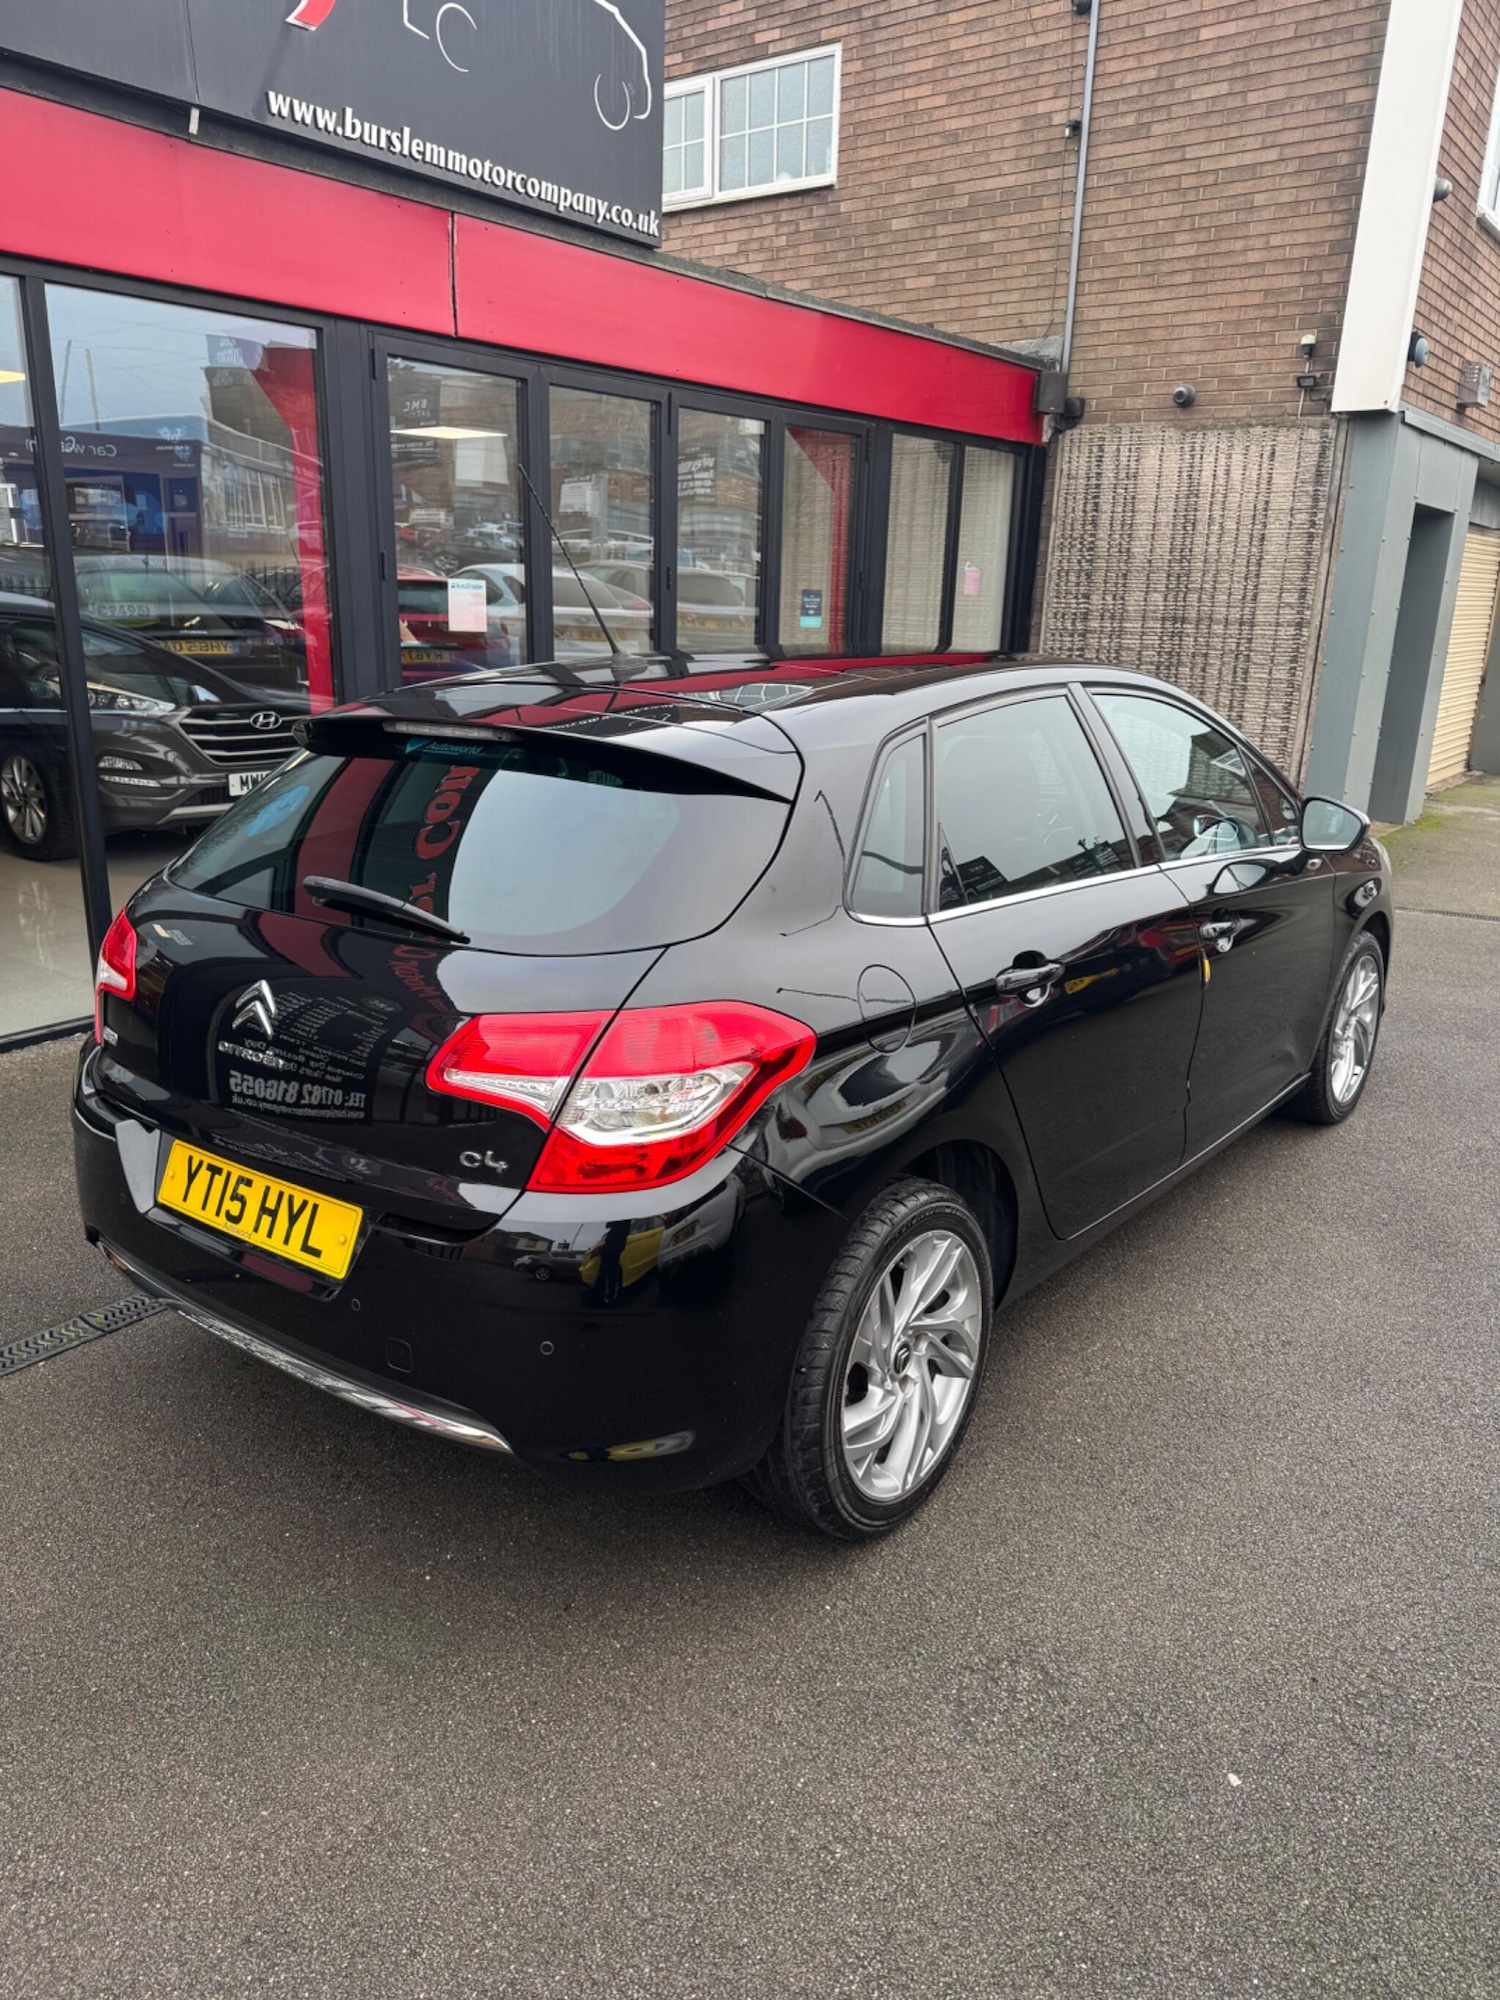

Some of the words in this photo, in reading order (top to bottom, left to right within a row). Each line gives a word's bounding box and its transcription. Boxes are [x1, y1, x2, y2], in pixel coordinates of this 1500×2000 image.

[266, 89, 661, 238] www.burslemmotorcompany.co.uk
[425, 741, 484, 756] Autoworld
[459, 1150, 509, 1174] C4
[182, 1155, 254, 1226] YT15
[253, 1185, 323, 1259] HYL
